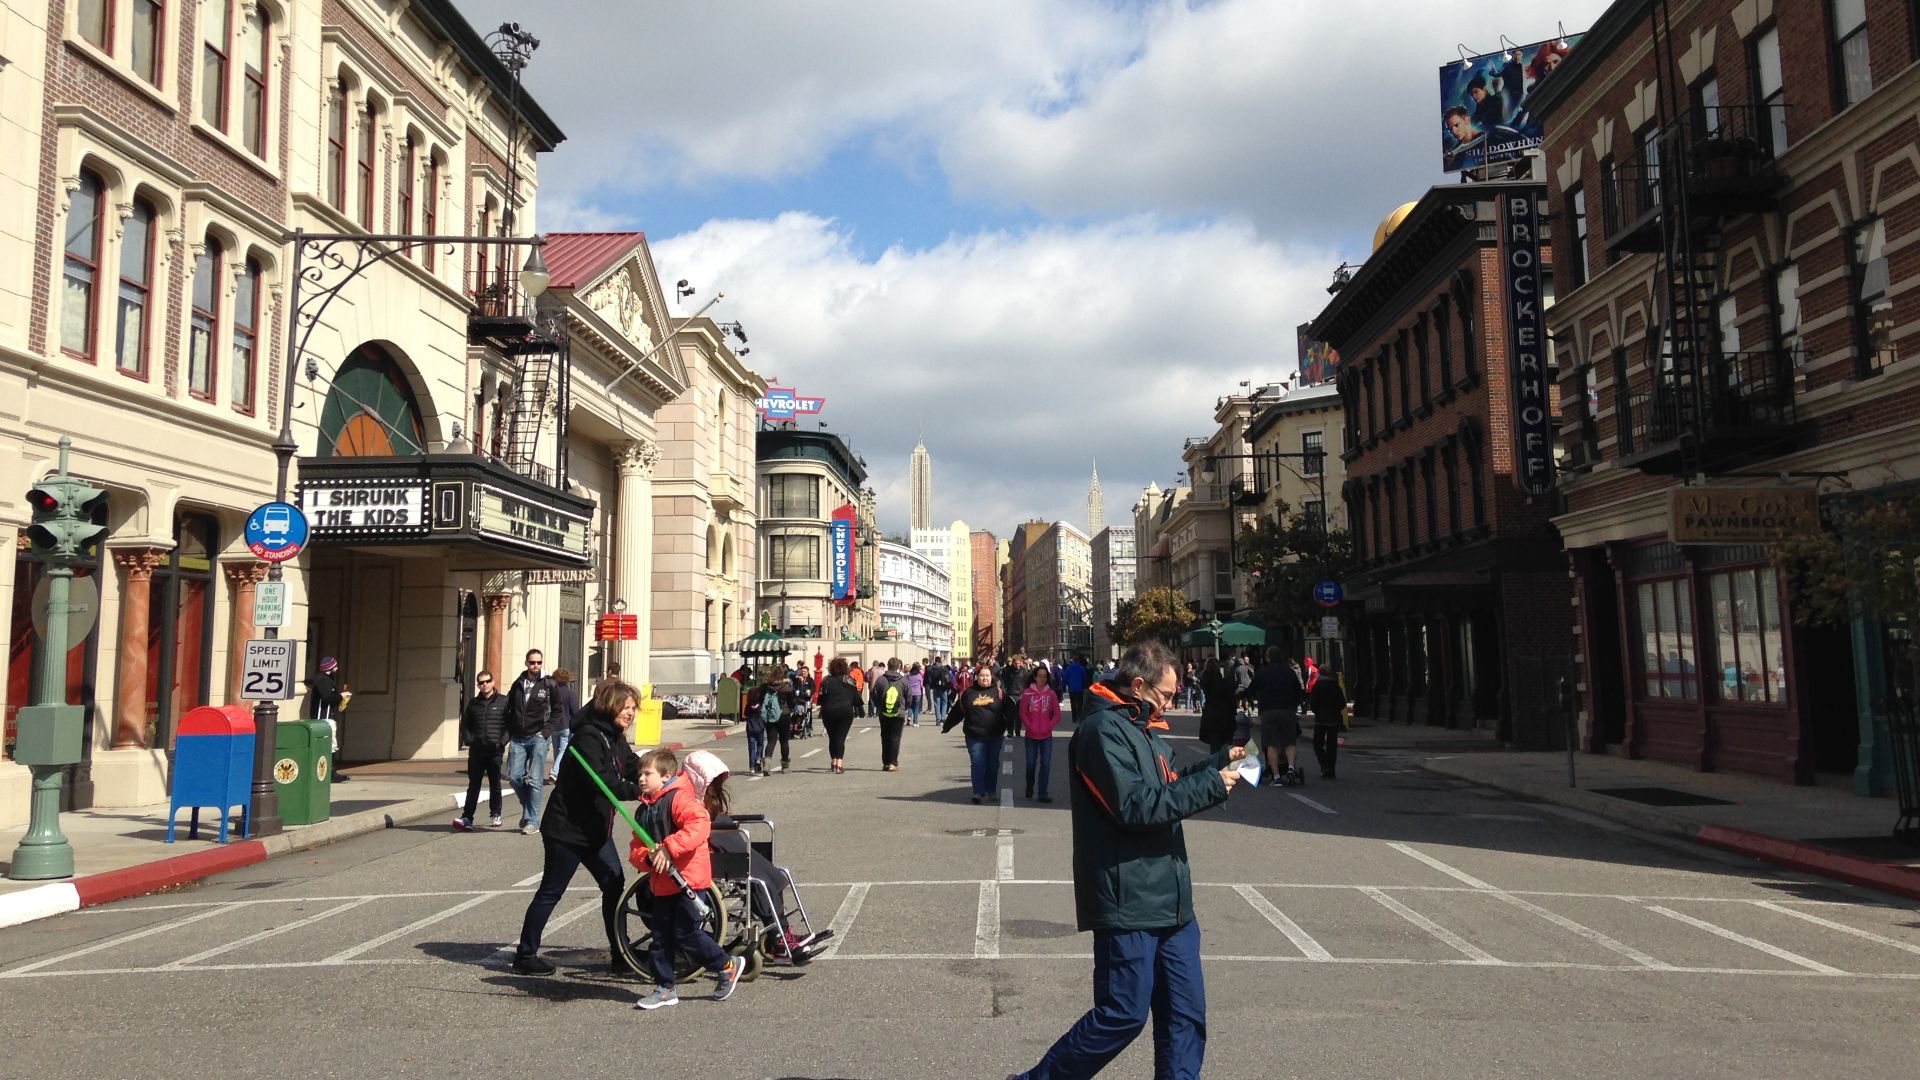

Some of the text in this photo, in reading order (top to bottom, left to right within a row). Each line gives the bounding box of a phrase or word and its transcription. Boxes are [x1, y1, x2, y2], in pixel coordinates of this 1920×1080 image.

[1465, 135, 1544, 158] SHADOWHUN
[1510, 198, 1544, 477] BROCKERHOFF
[755, 398, 815, 411] HEVROLET
[313, 489, 409, 506] I SHRUNK
[315, 509, 409, 526] THE KIDS
[252, 545, 298, 559] NO STANDING
[836, 525, 847, 588] CHEVROLET
[527, 567, 596, 583] DIAMONDS
[264, 587, 277, 595] ONE
[261, 596, 278, 604] HOUR
[256, 604, 281, 612] PARKING
[249, 646, 286, 655] SPEED
[252, 659, 281, 668] LIMIT
[244, 671, 284, 694] 25
